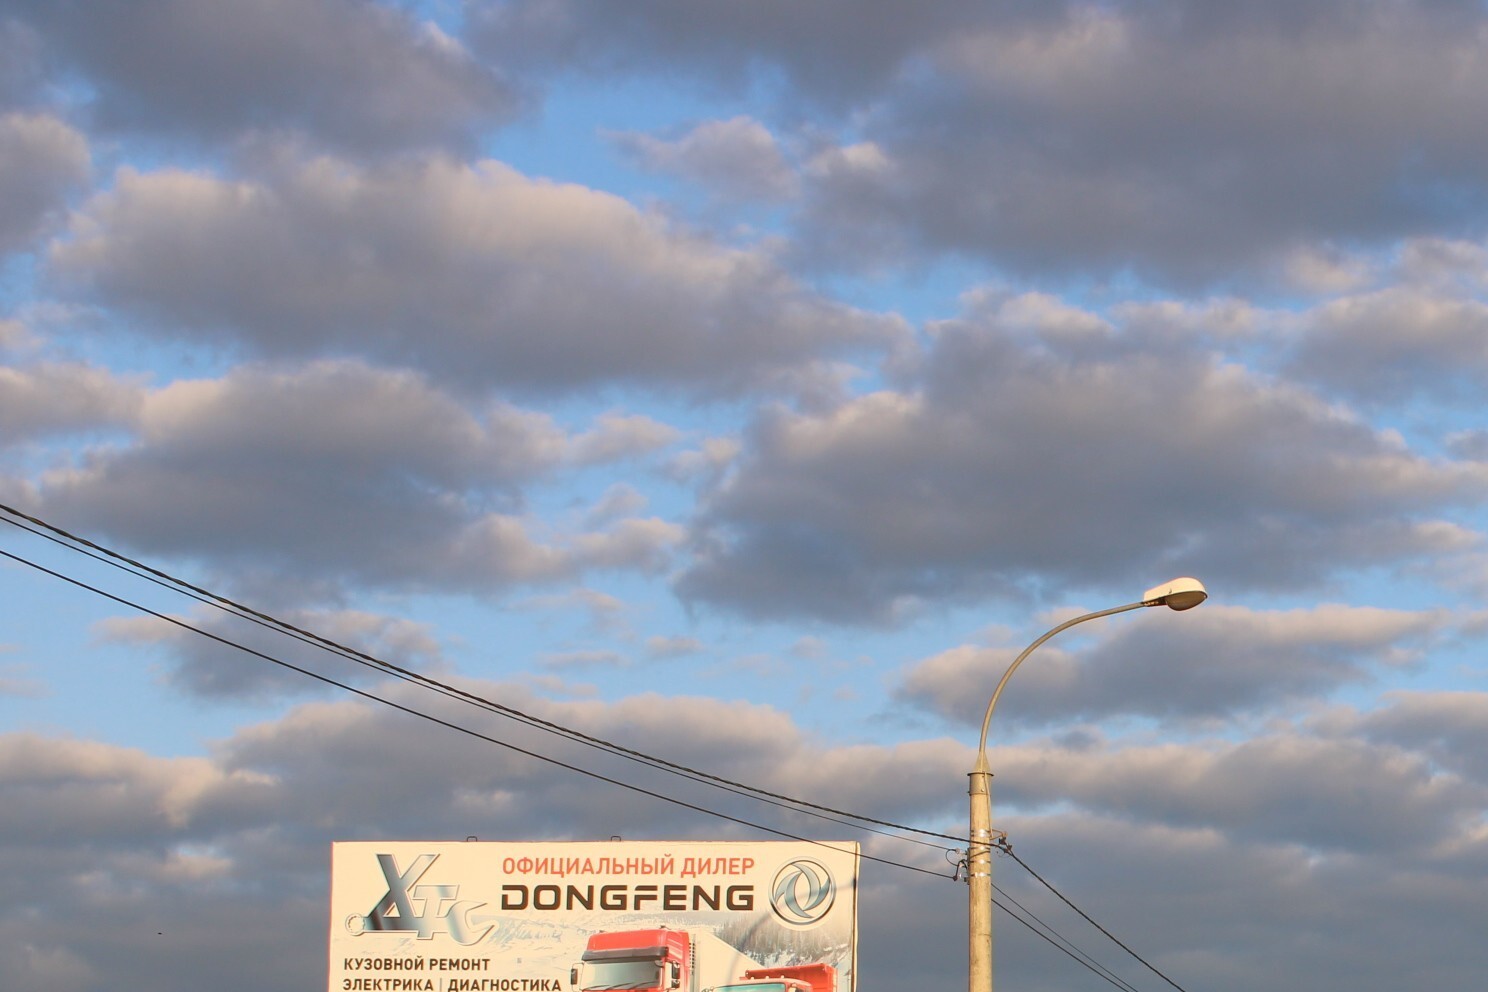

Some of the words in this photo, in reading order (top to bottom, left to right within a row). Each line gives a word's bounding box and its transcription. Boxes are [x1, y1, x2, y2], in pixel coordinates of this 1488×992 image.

[502, 853, 674, 878] ОФИЦИАЛЬНЫЙ
[680, 857, 754, 878] ДИЛЕР
[501, 884, 754, 911] DONGFENG
[344, 955, 424, 971] КУЗОВНОЙ
[429, 958, 490, 971] РЕМОНТ
[343, 978, 434, 991] ЭЛЕКТРИКА
